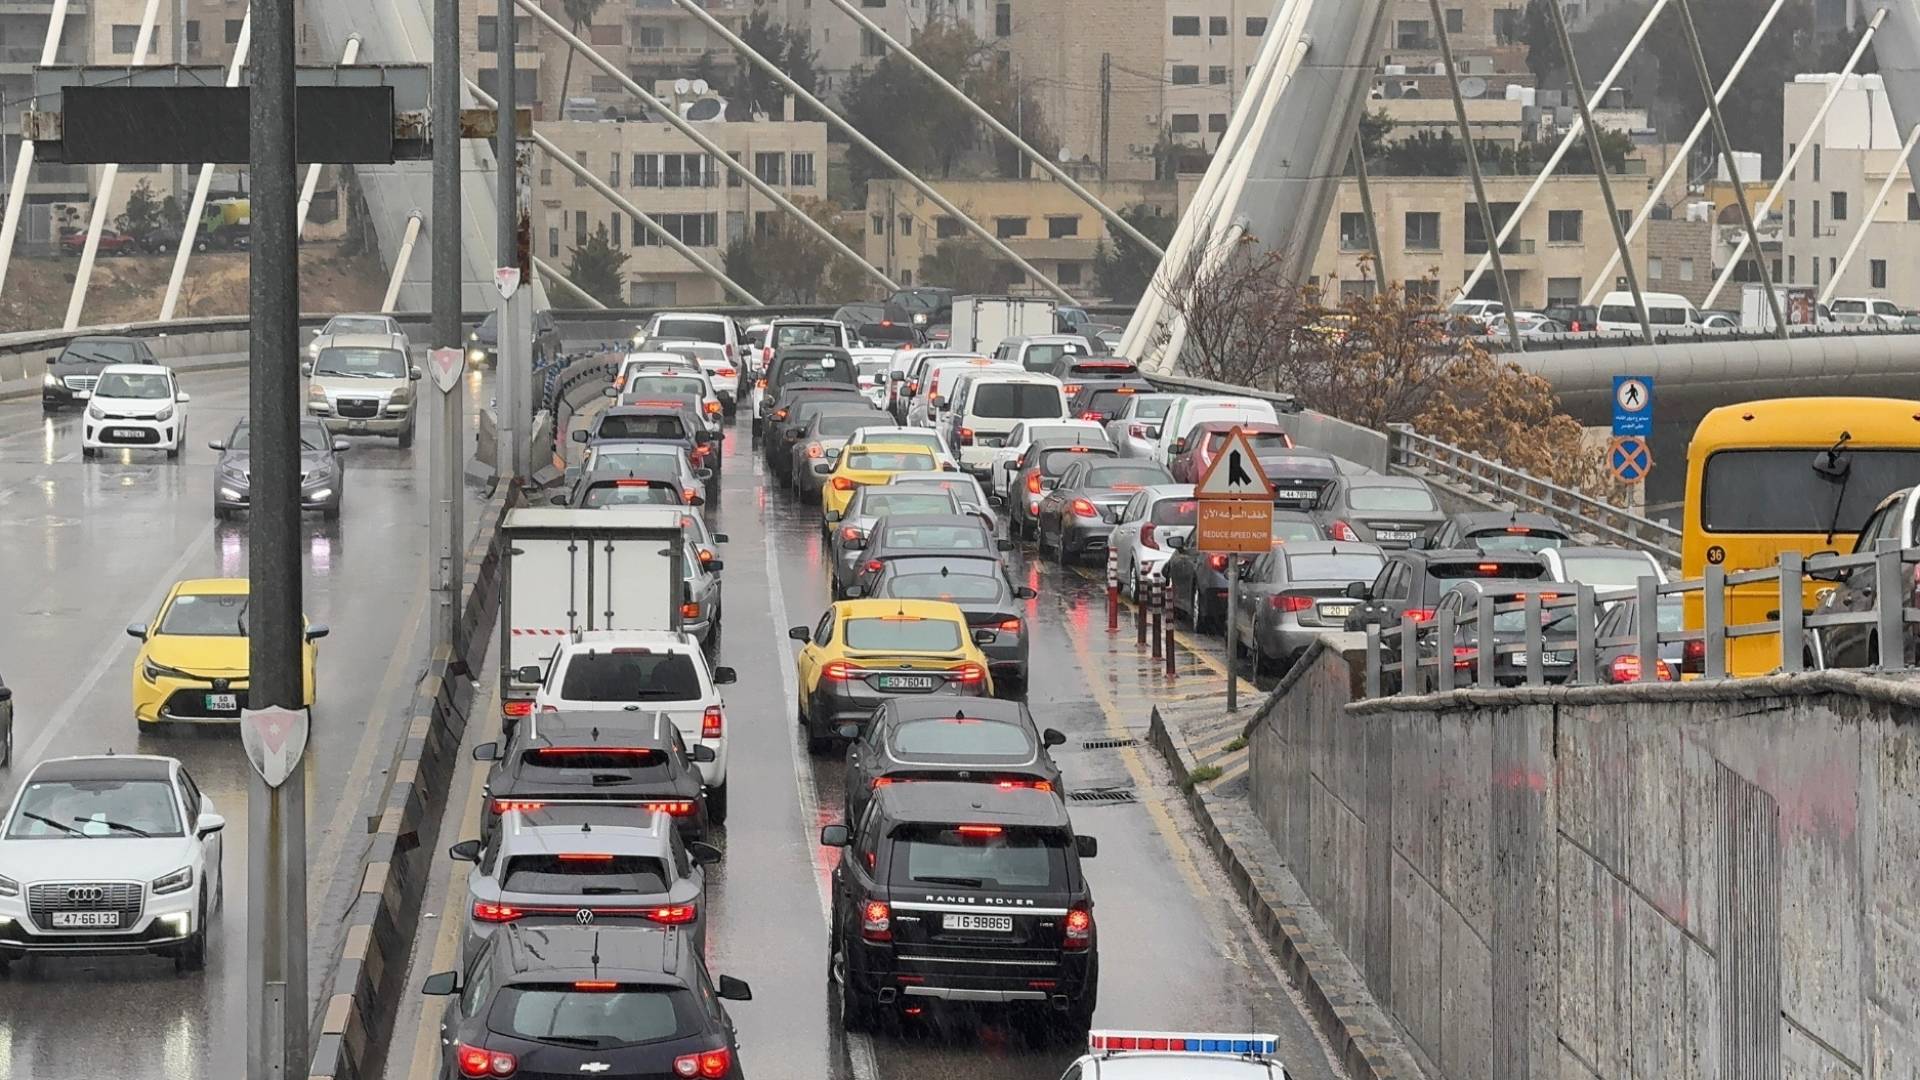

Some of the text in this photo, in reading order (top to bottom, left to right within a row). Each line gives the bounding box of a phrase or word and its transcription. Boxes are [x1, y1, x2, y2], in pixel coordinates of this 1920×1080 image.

[1203, 530, 1268, 539] REDUCE SPEED NOW
[1710, 549, 1722, 561] 36
[925, 895, 975, 903] RANGE
[64, 913, 117, 924] 47-66133
[957, 916, 1010, 929] 16-98869
